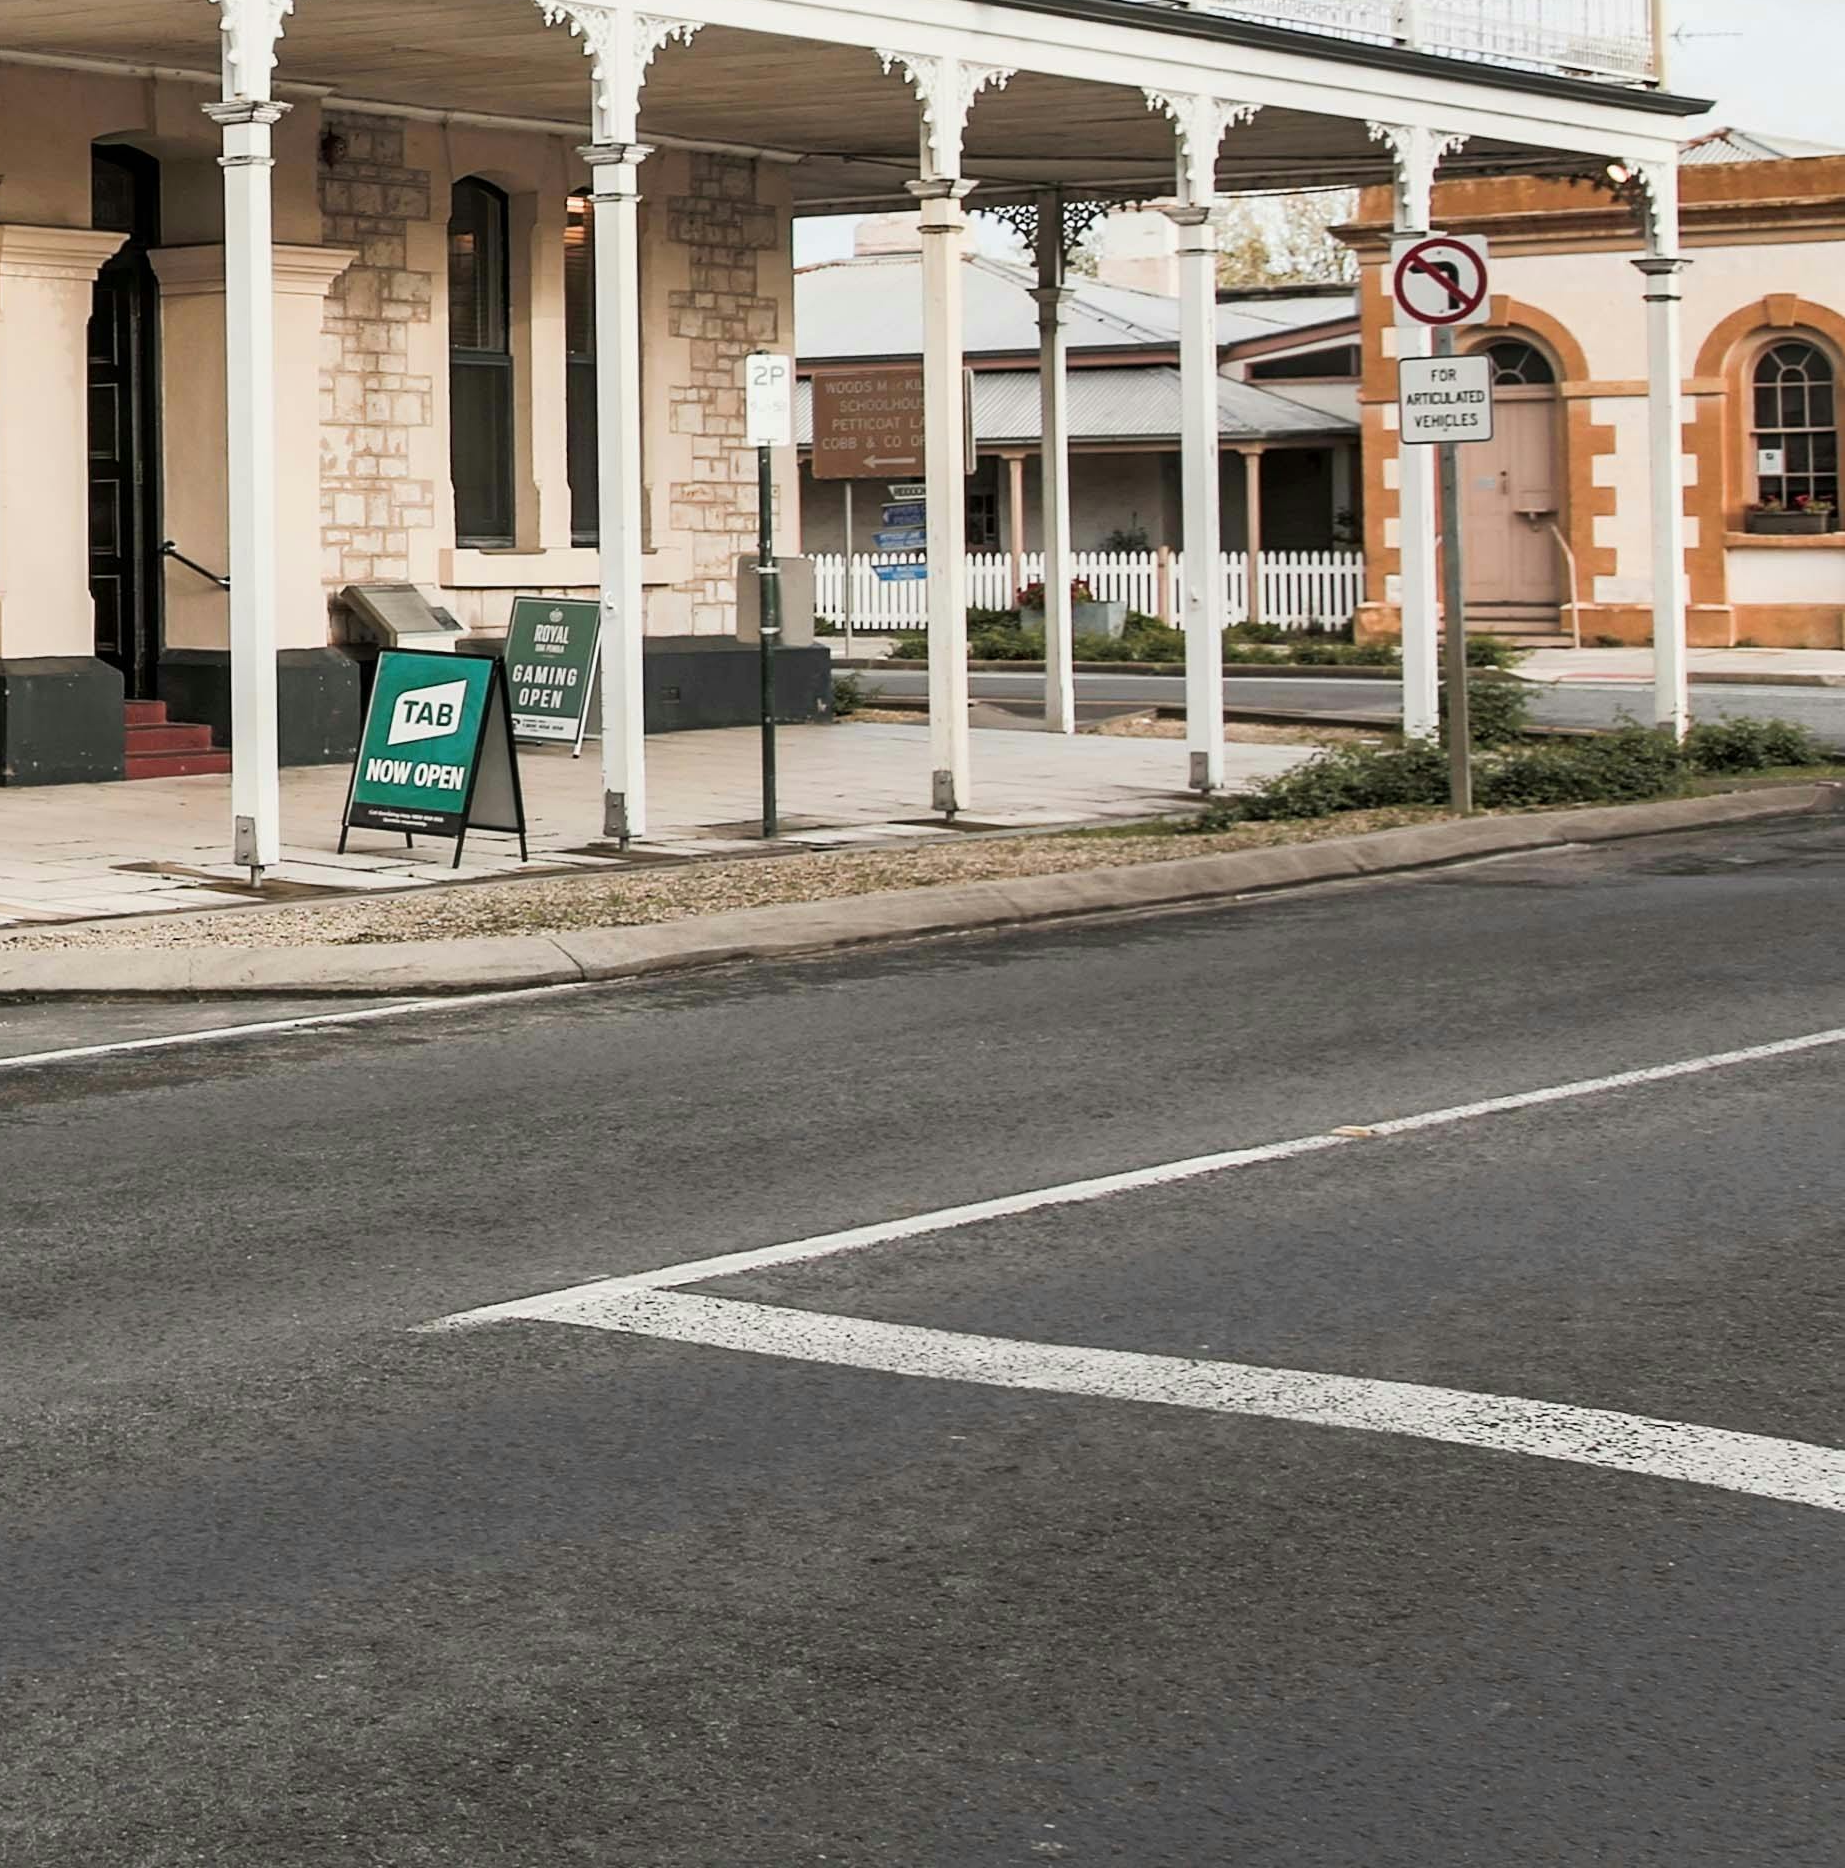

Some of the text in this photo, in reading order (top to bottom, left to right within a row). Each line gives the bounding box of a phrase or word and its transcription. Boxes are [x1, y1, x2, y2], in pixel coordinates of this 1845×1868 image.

[753, 365, 786, 386] 2P
[1431, 368, 1457, 382] FOR
[825, 379, 873, 394] WOODS
[1407, 390, 1485, 406] ARTICULATED
[831, 416, 901, 431] PETTICOAT
[1414, 413, 1478, 428] VEHICLES
[822, 437, 857, 451] COBB
[883, 434, 903, 449] CO
[533, 624, 570, 645] ROYAL
[512, 664, 578, 686] GAMING
[518, 687, 563, 709] OPEN
[402, 699, 454, 727] TAB
[365, 758, 465, 791] NOW OPEN
